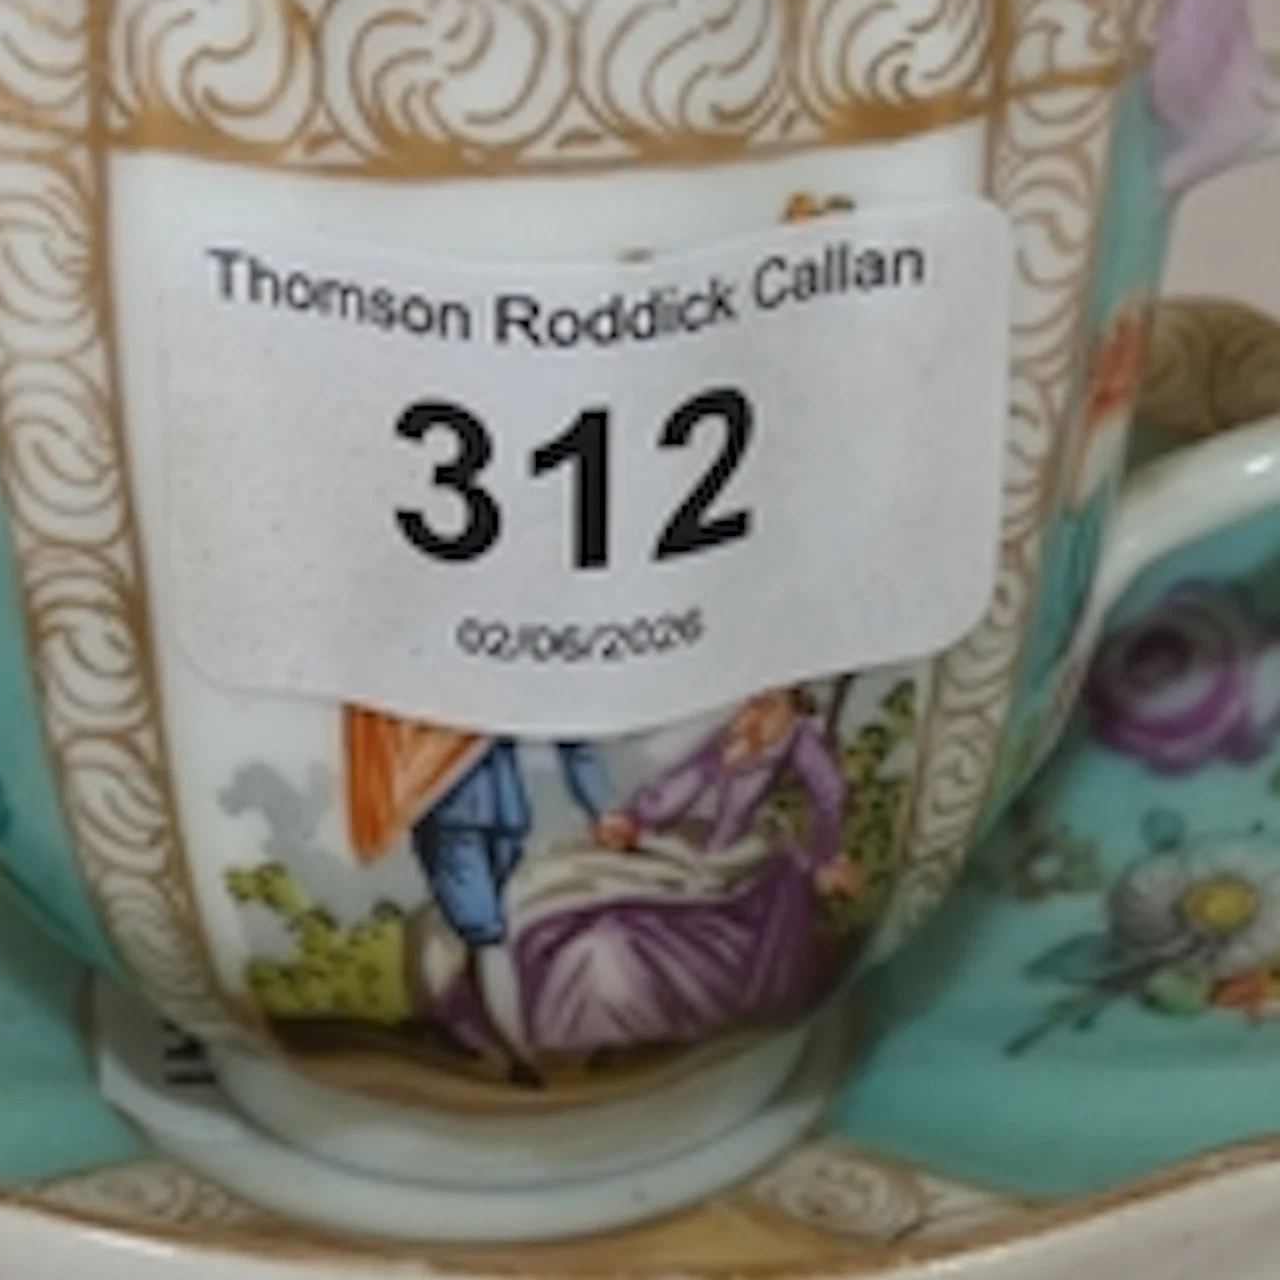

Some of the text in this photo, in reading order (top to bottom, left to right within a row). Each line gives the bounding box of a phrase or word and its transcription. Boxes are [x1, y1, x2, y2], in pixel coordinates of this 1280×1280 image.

[208, 241, 927, 350] Thomson Roddick Callan
[392, 384, 757, 572] 312
[455, 605, 705, 663] 02/06/2026
